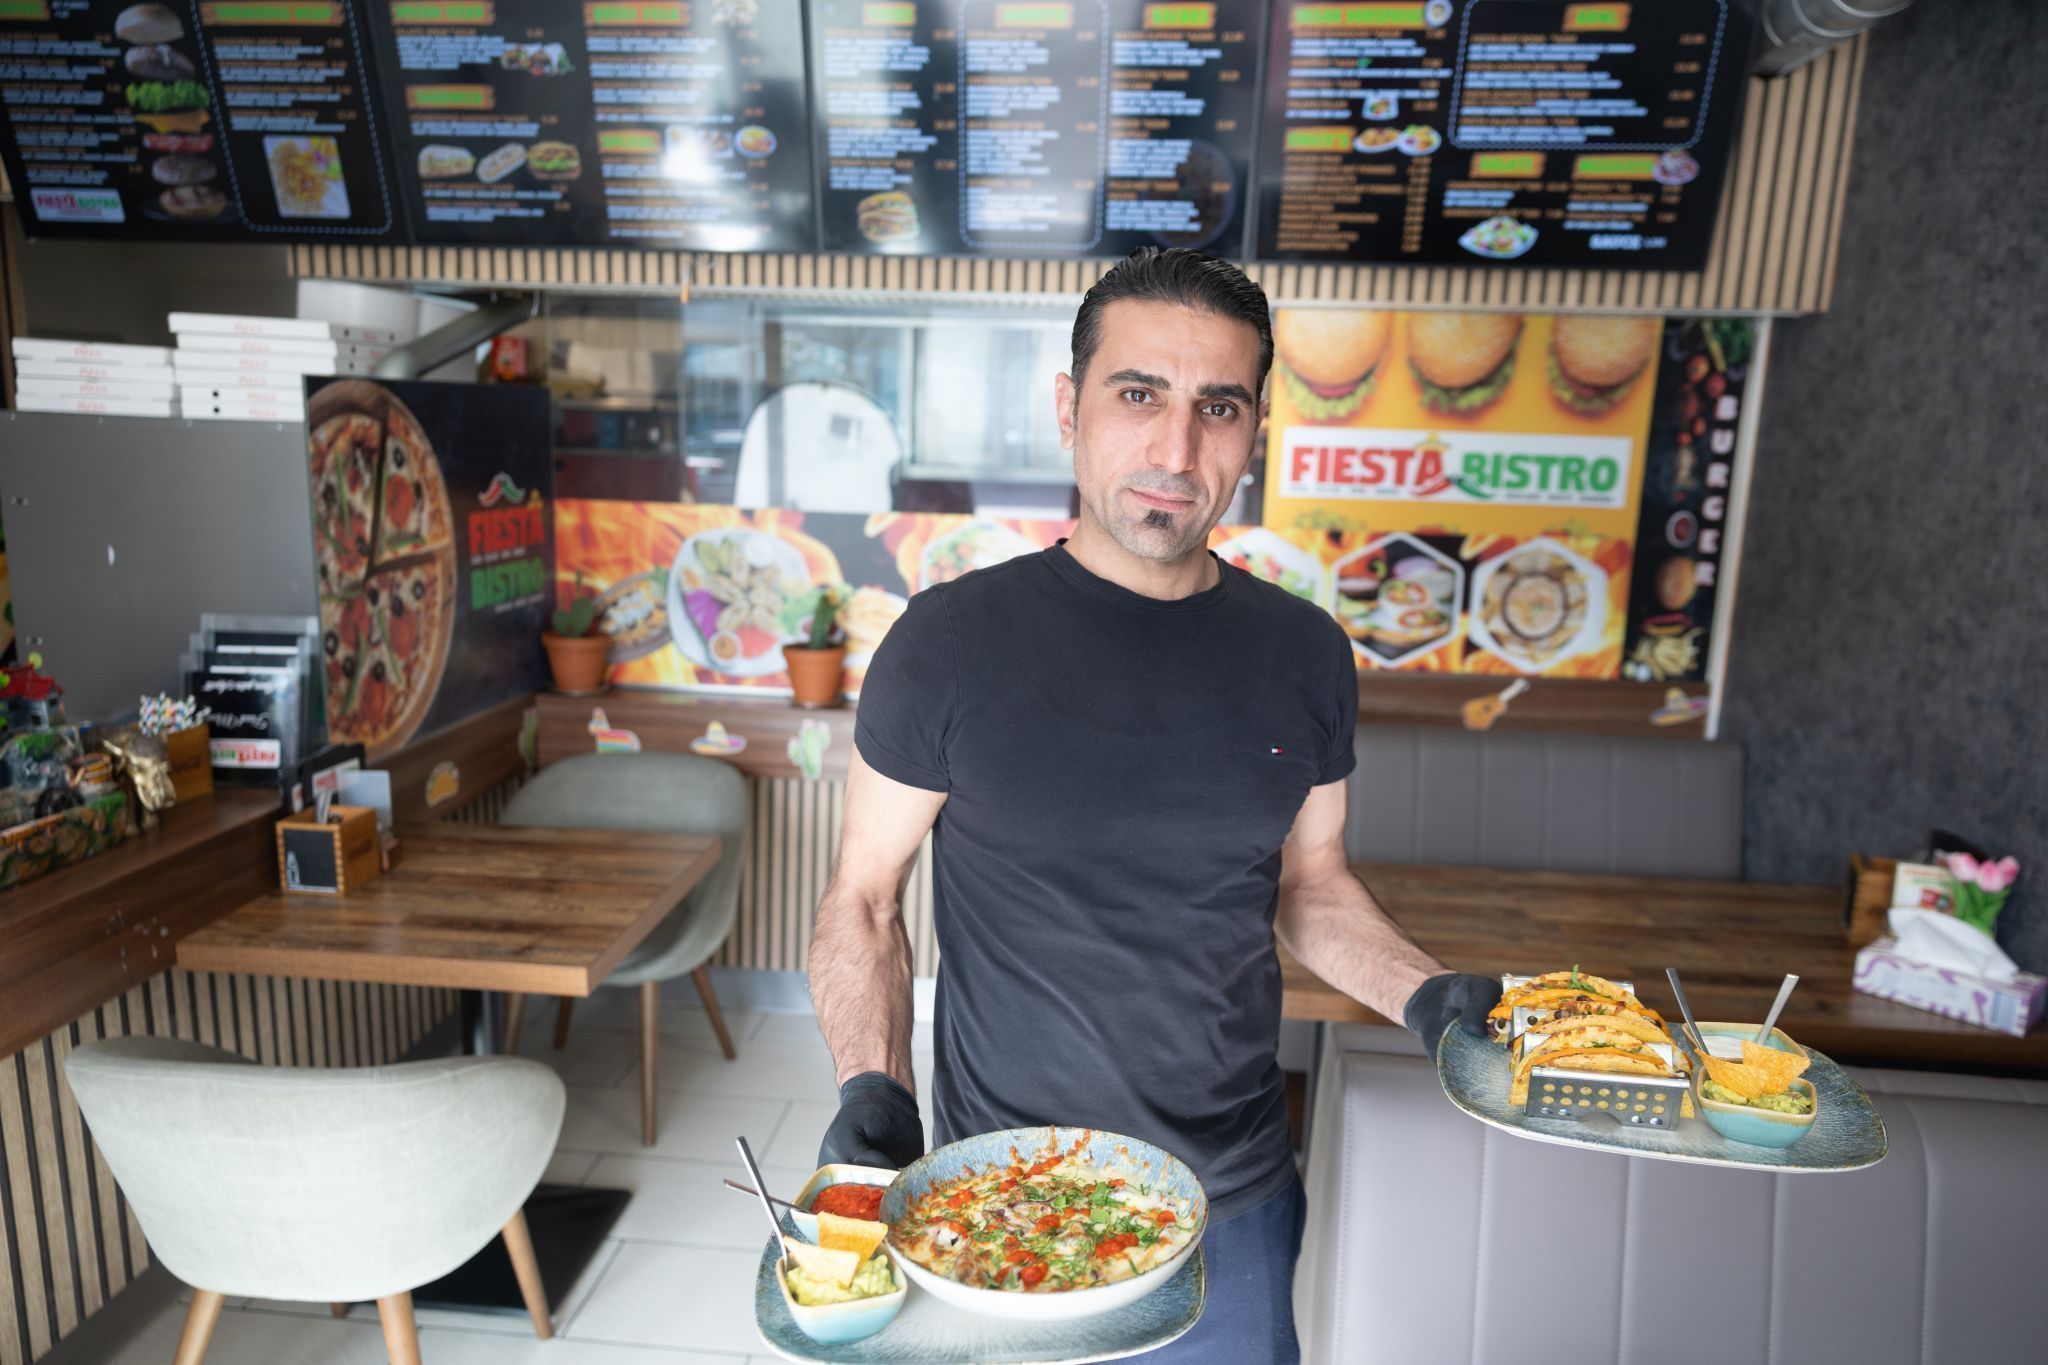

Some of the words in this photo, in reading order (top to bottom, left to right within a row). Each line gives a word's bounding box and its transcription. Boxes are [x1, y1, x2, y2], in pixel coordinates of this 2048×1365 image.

[1291, 446, 1445, 487] FIESTA
[1462, 453, 1618, 492] BISTRO
[468, 507, 545, 557] FIESTA
[471, 556, 546, 611] BISTRO
